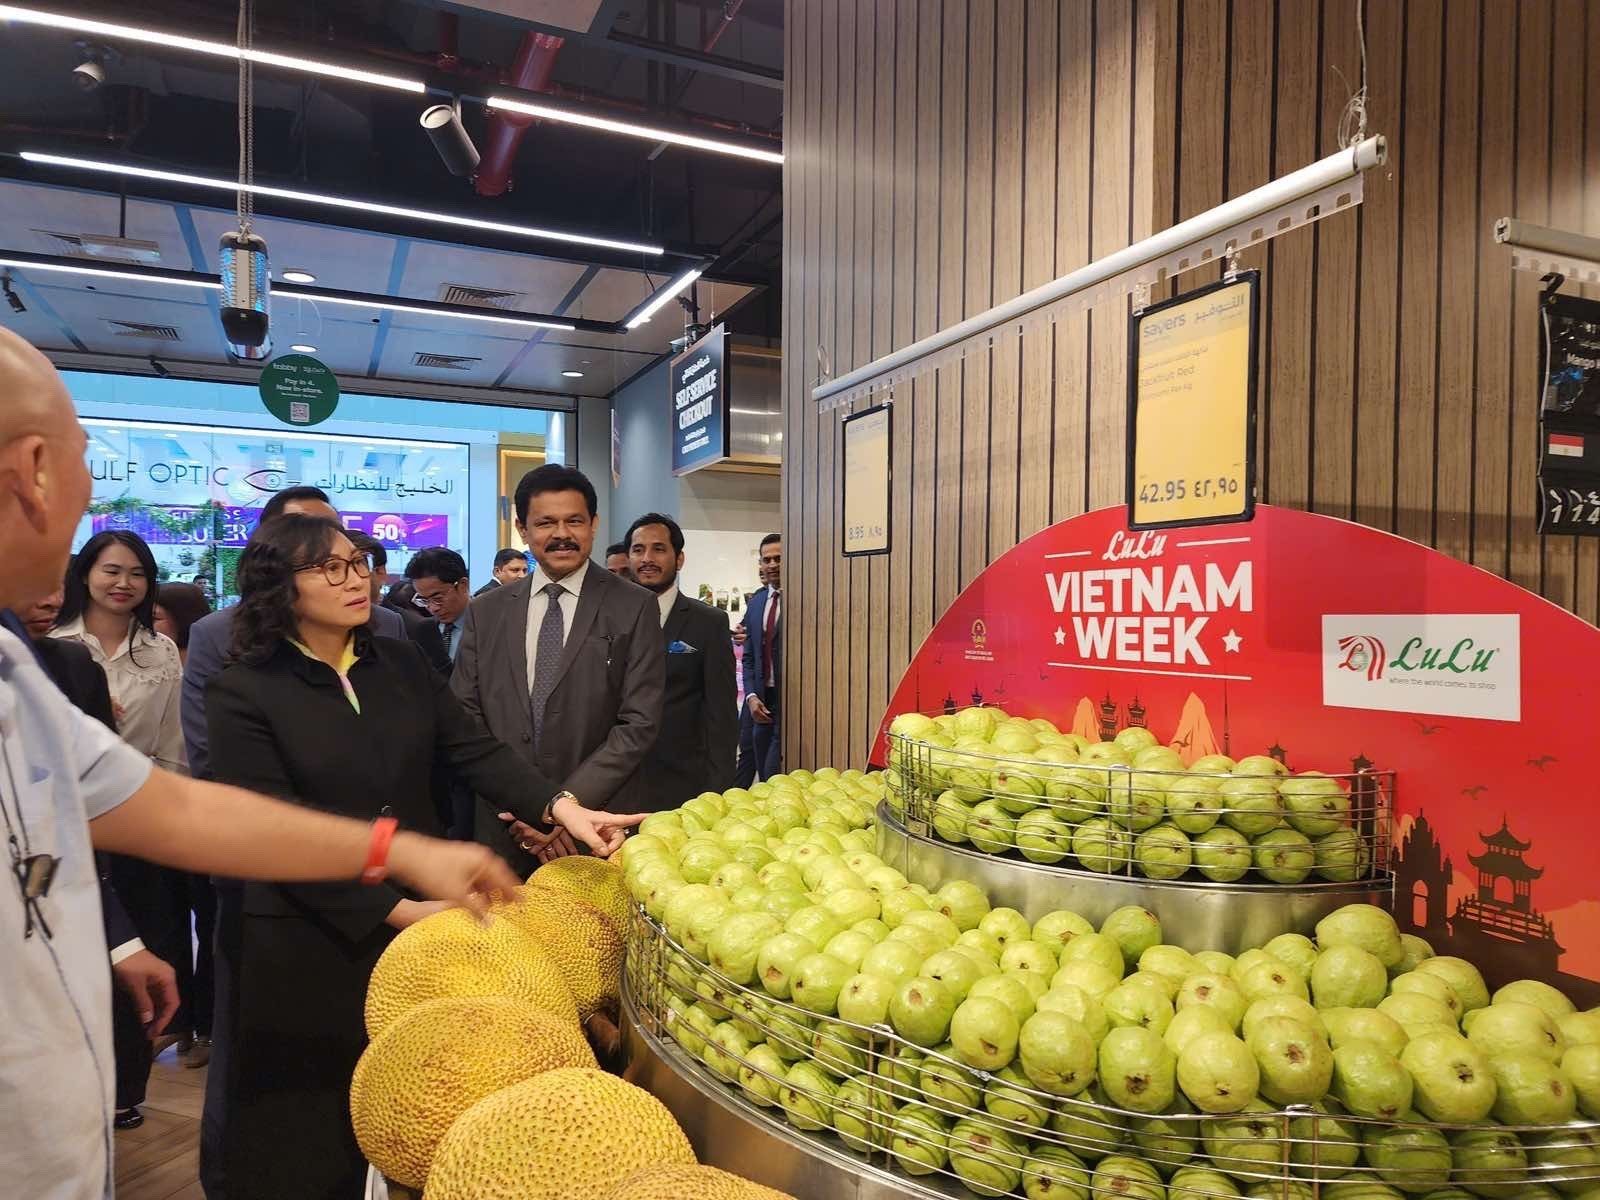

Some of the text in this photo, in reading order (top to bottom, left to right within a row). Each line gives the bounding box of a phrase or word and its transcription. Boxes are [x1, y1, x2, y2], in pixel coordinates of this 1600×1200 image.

[90, 459, 230, 487] ULF OPTIC
[395, 476, 454, 498] الخليج
[1139, 479, 1186, 504] 42.95
[1101, 530, 1169, 562] LuLu
[1045, 561, 1253, 613] VIETNAM
[1072, 616, 1211, 666] WEEK
[1389, 637, 1495, 673] LuLu
